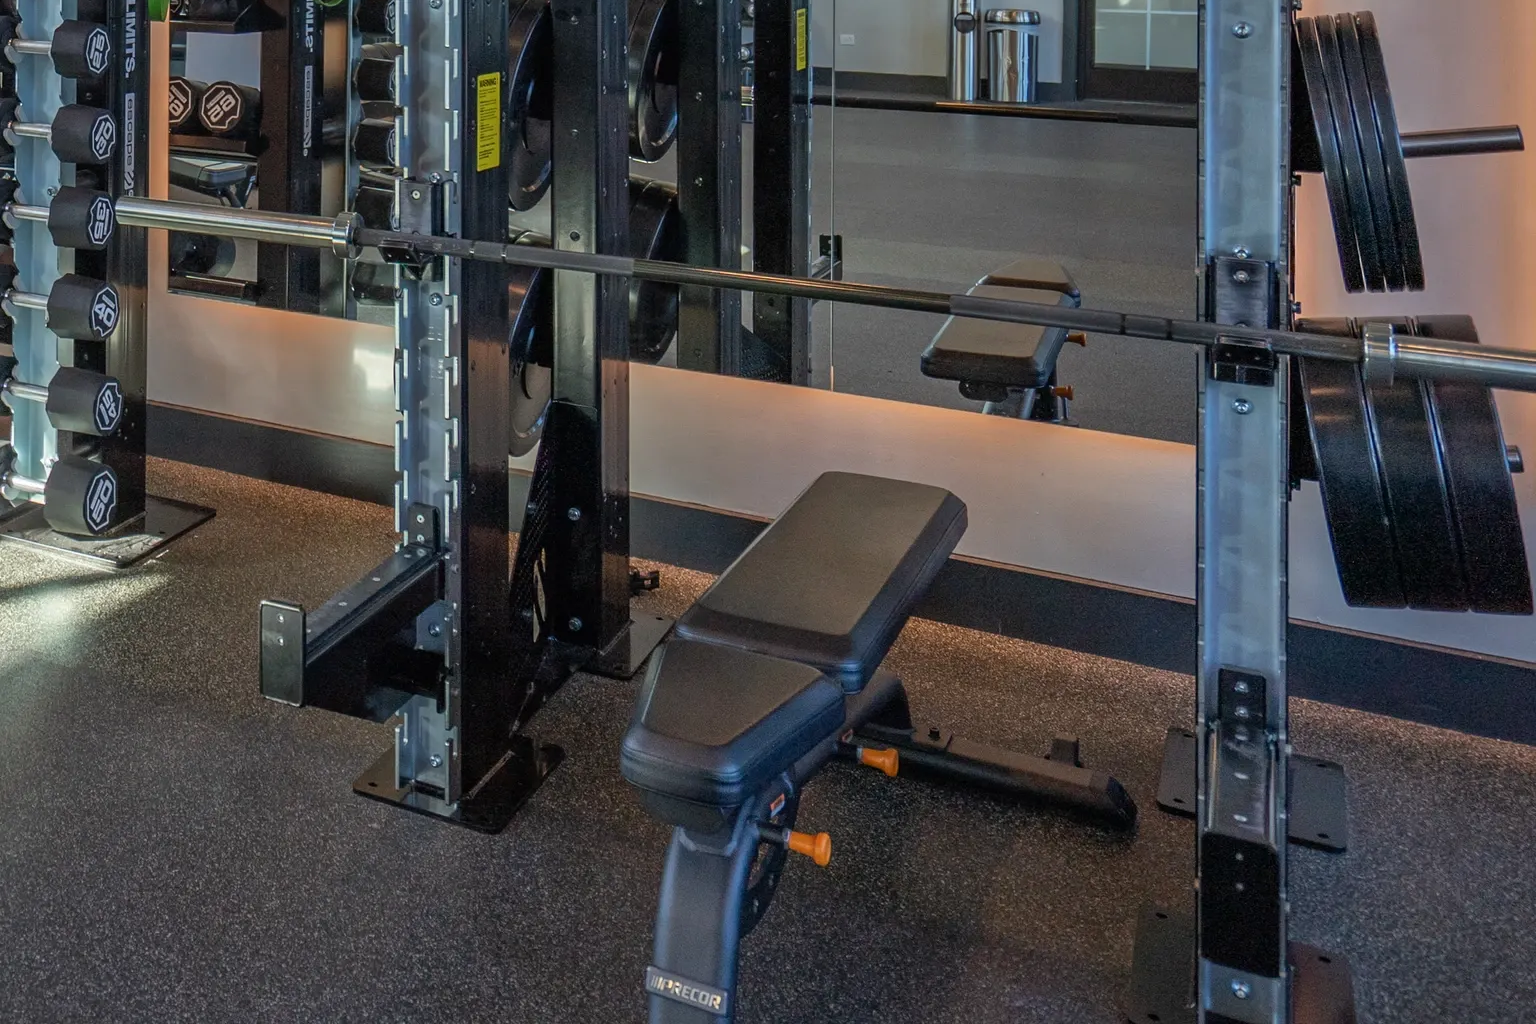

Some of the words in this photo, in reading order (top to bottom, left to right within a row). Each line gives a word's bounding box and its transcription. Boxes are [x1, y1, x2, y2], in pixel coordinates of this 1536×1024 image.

[92, 34, 104, 68] 25
[98, 122, 112, 155] 30
[126, 99, 134, 167] escape
[93, 201, 107, 241] 35
[95, 297, 114, 327] 40
[103, 388, 119, 423] 45
[94, 480, 114, 522] 50
[659, 977, 722, 1010] PRECOR
